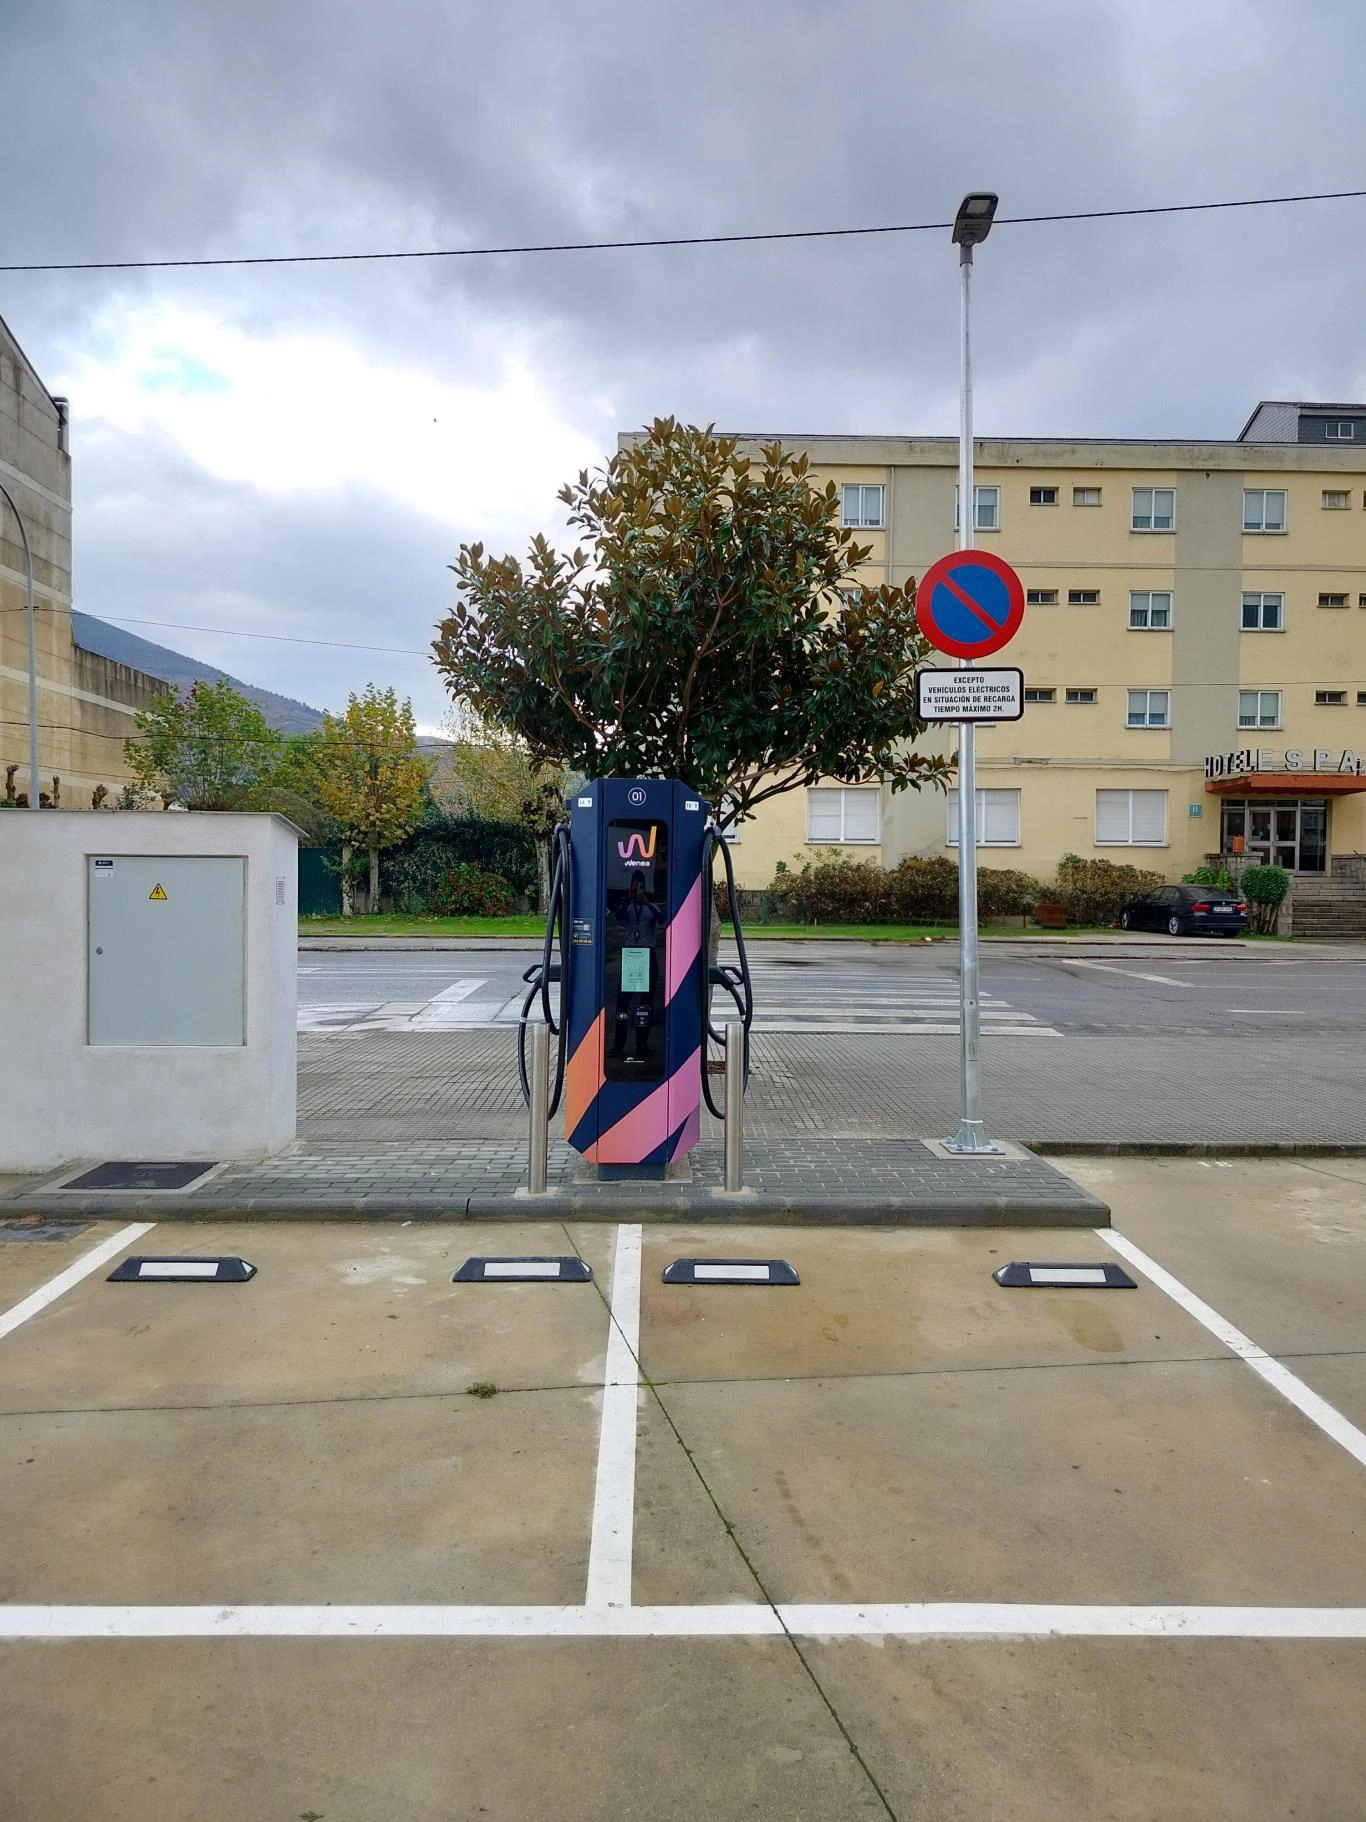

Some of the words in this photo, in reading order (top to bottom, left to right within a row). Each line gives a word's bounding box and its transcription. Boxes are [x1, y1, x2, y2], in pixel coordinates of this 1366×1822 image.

[953, 676, 985, 684] EXCEPTO
[928, 685, 967, 694] VEHÍCULOS
[968, 685, 1010, 694] ELÉCTRICOS
[923, 696, 932, 704] EN
[934, 694, 971, 704] SITUACIÓN
[972, 695, 982, 703] DE
[983, 695, 1016, 703] RECARGA
[934, 705, 960, 713] TIEMPO
[962, 703, 991, 713] MÁXIMO
[1204, 749, 1254, 777] HOTEL
[631, 792, 642, 801] 01
